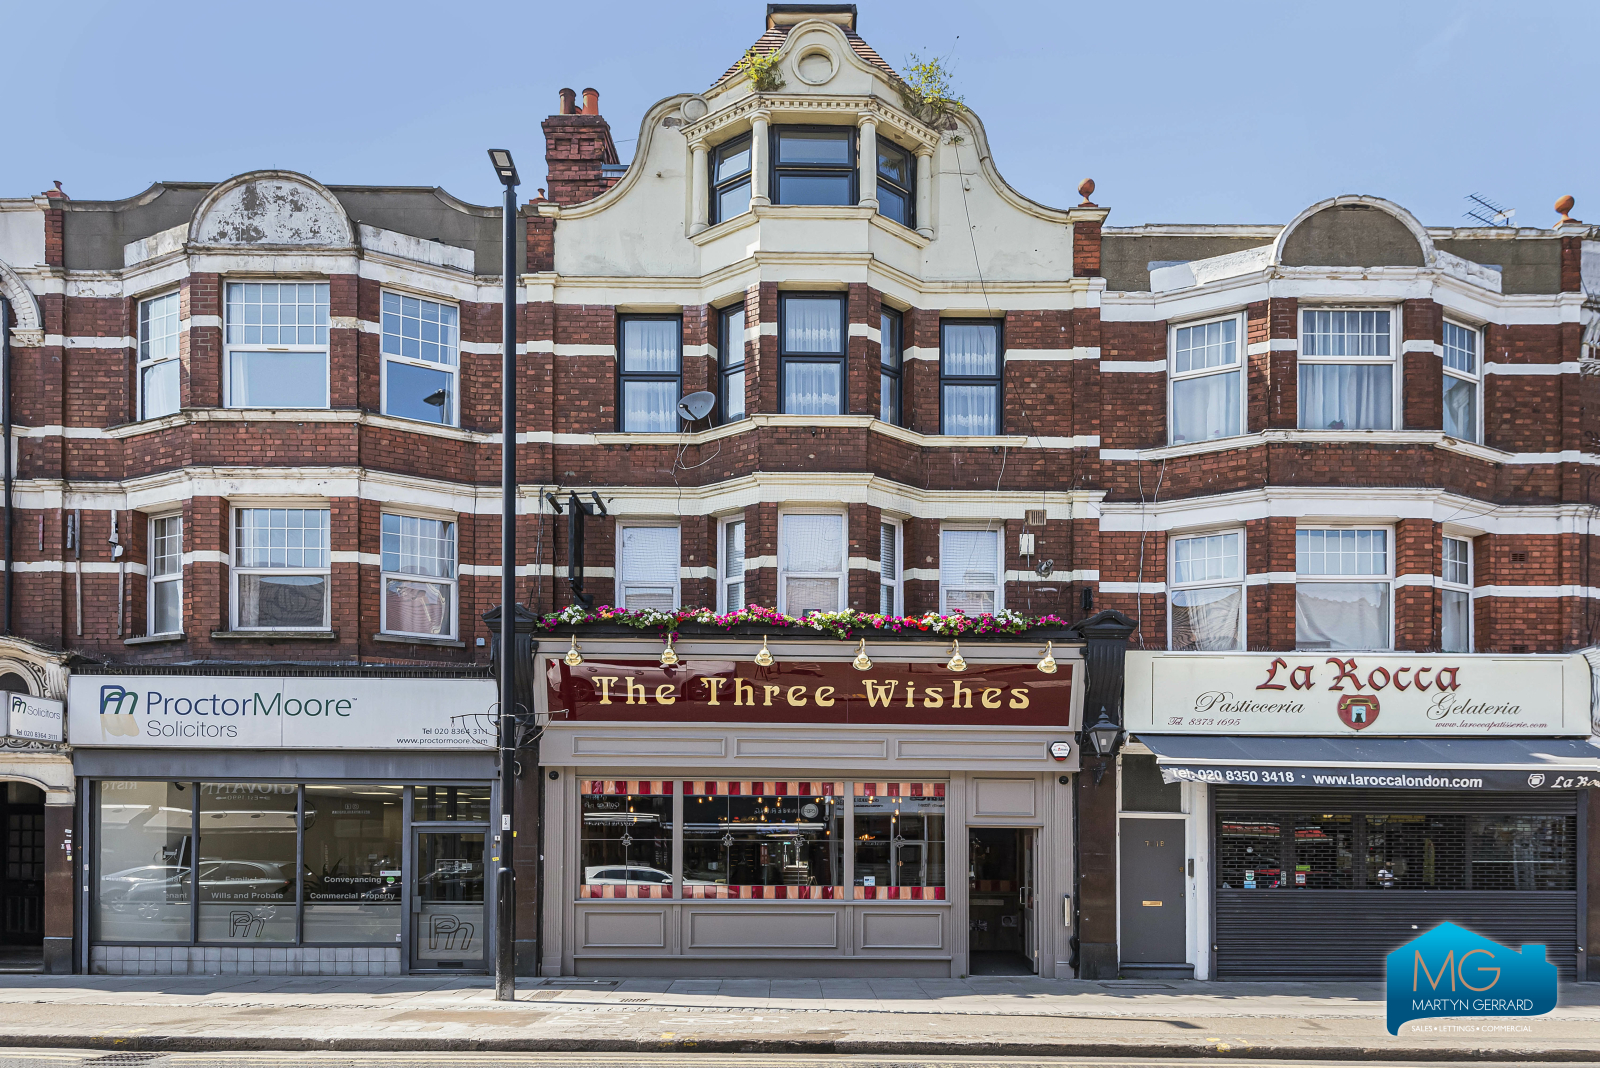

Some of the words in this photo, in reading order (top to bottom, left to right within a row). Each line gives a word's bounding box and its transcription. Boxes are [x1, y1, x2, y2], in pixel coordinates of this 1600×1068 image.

[1256, 658, 1316, 690] La
[1326, 657, 1462, 692] Rocca
[592, 676, 676, 704] The
[701, 677, 835, 707] Three
[862, 680, 1030, 709] Wishes
[1194, 691, 1306, 714] Pasticceria
[1426, 692, 1522, 720] Gelateria
[27, 706, 60, 720] Solicitors
[146, 720, 238, 738] Solicitors
[1188, 718, 1214, 726] 8373
[1216, 717, 1241, 726] 1695
[1435, 720, 1548, 731] www.laroccapatisserie.com
[1198, 770, 1222, 781] 020
[1226, 770, 1258, 782] 8350
[1261, 771, 1294, 783] 3418
[1312, 774, 1482, 788] www.laroccalondon.com
[1550, 776, 1574, 788] La
[324, 876, 382, 884] Conveyancing
[361, 892, 395, 900] Property
